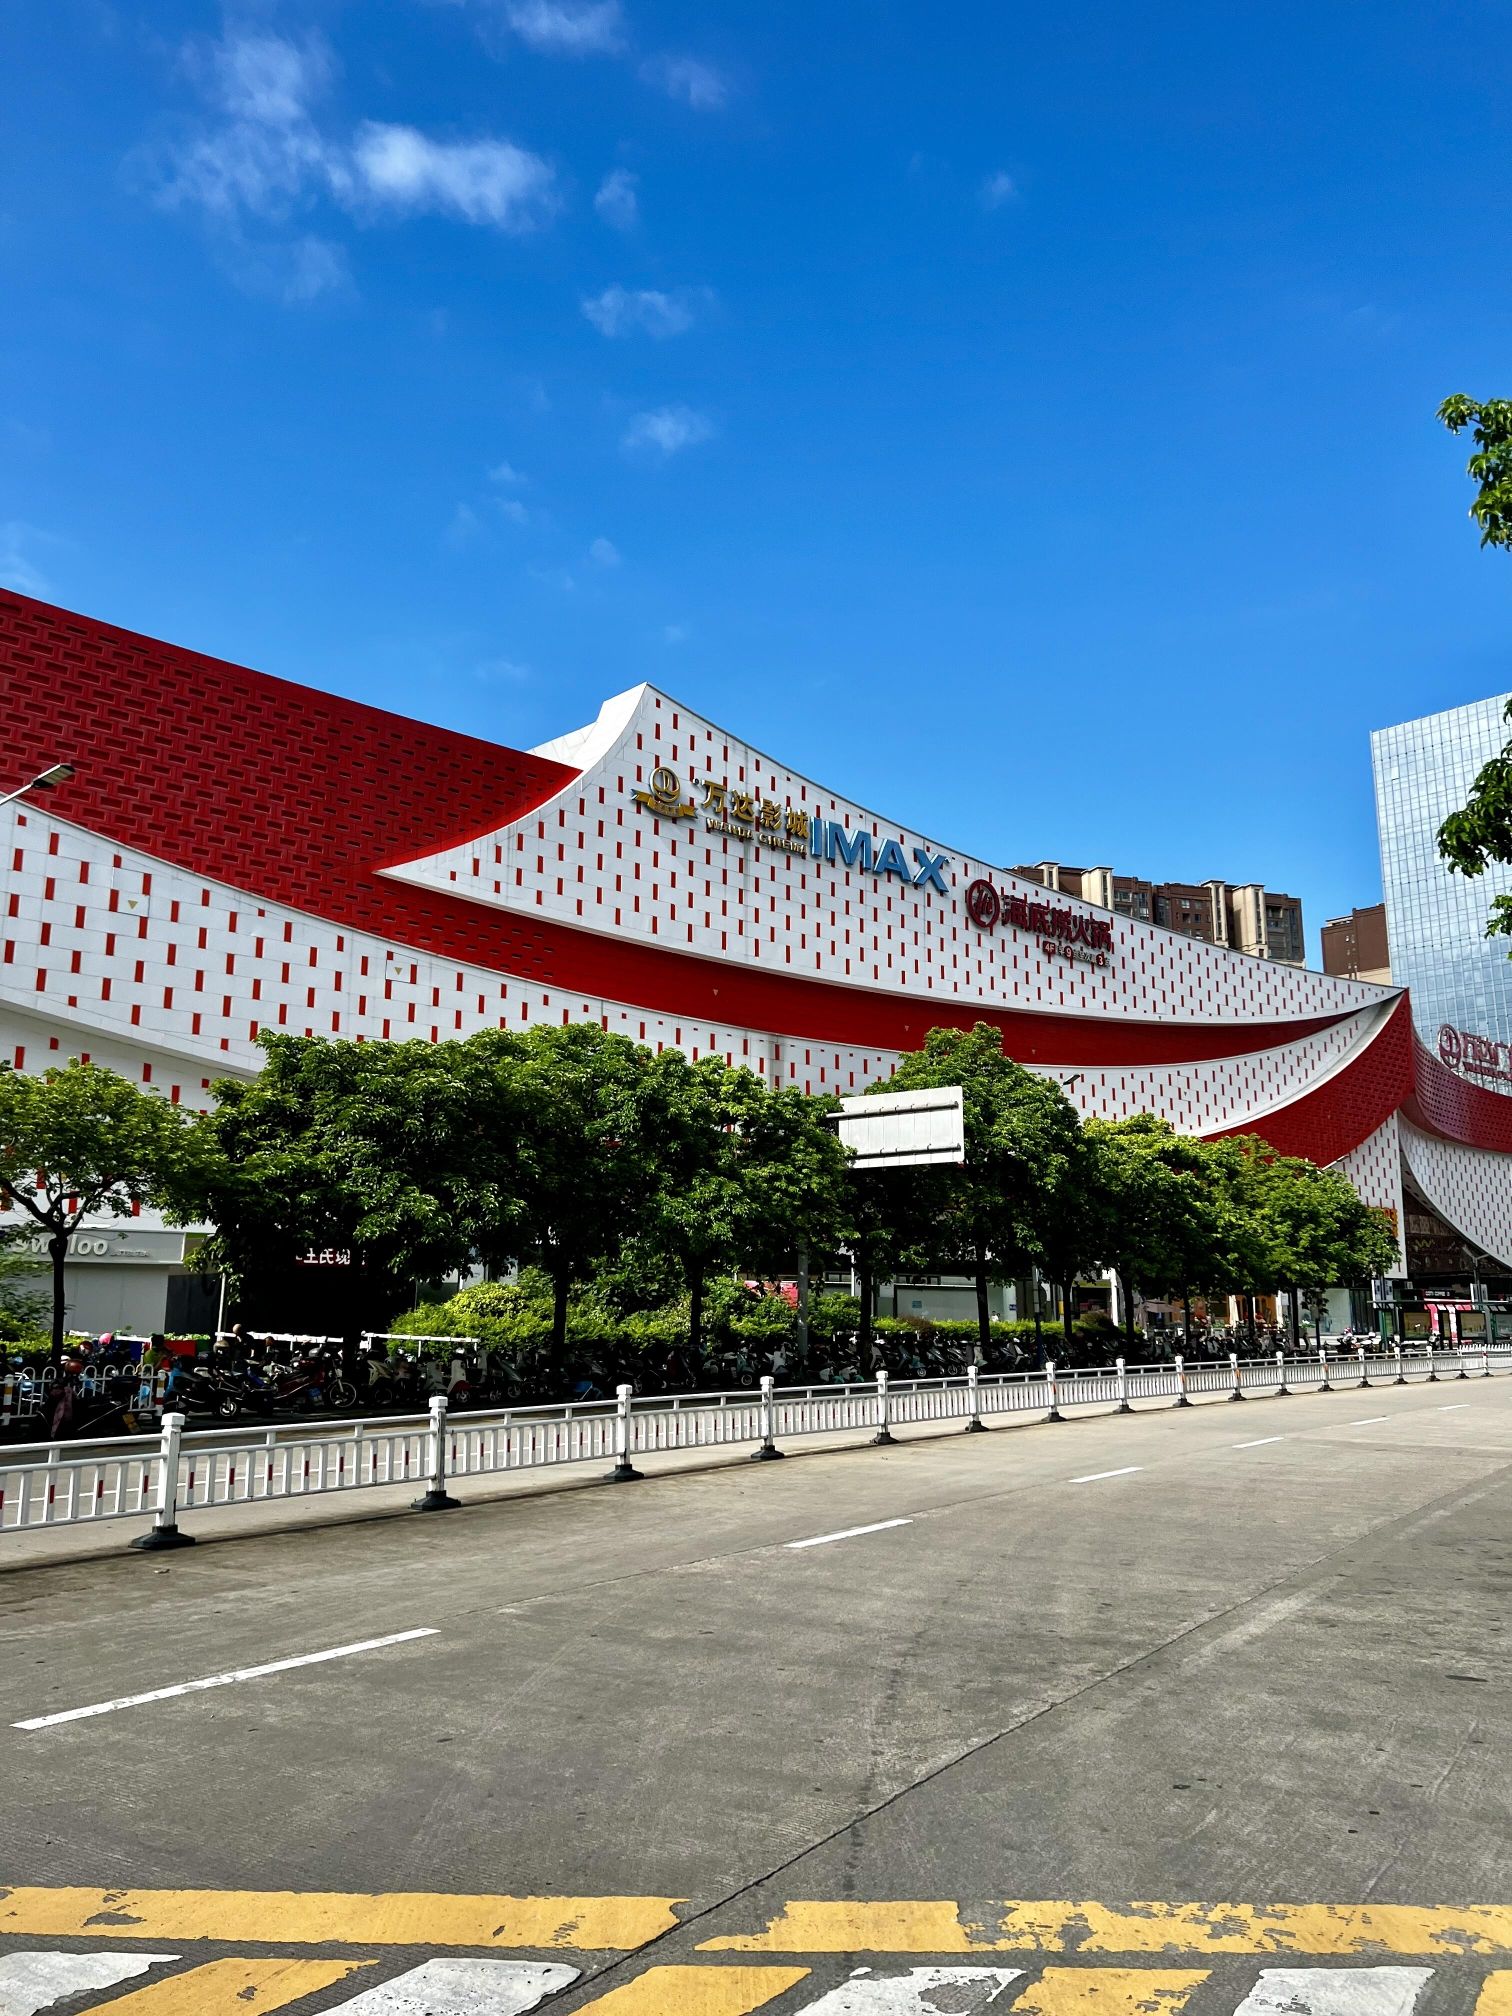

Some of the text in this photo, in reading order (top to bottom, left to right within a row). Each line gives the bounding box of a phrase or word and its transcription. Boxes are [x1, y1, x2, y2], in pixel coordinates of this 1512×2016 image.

[702, 779, 809, 839] 万达影城
[706, 818, 807, 856] WANDA CINEMA
[810, 816, 949, 893] IMAX
[1044, 942, 1055, 953] 4F
[1461, 1032, 1512, 1070] 万达广
